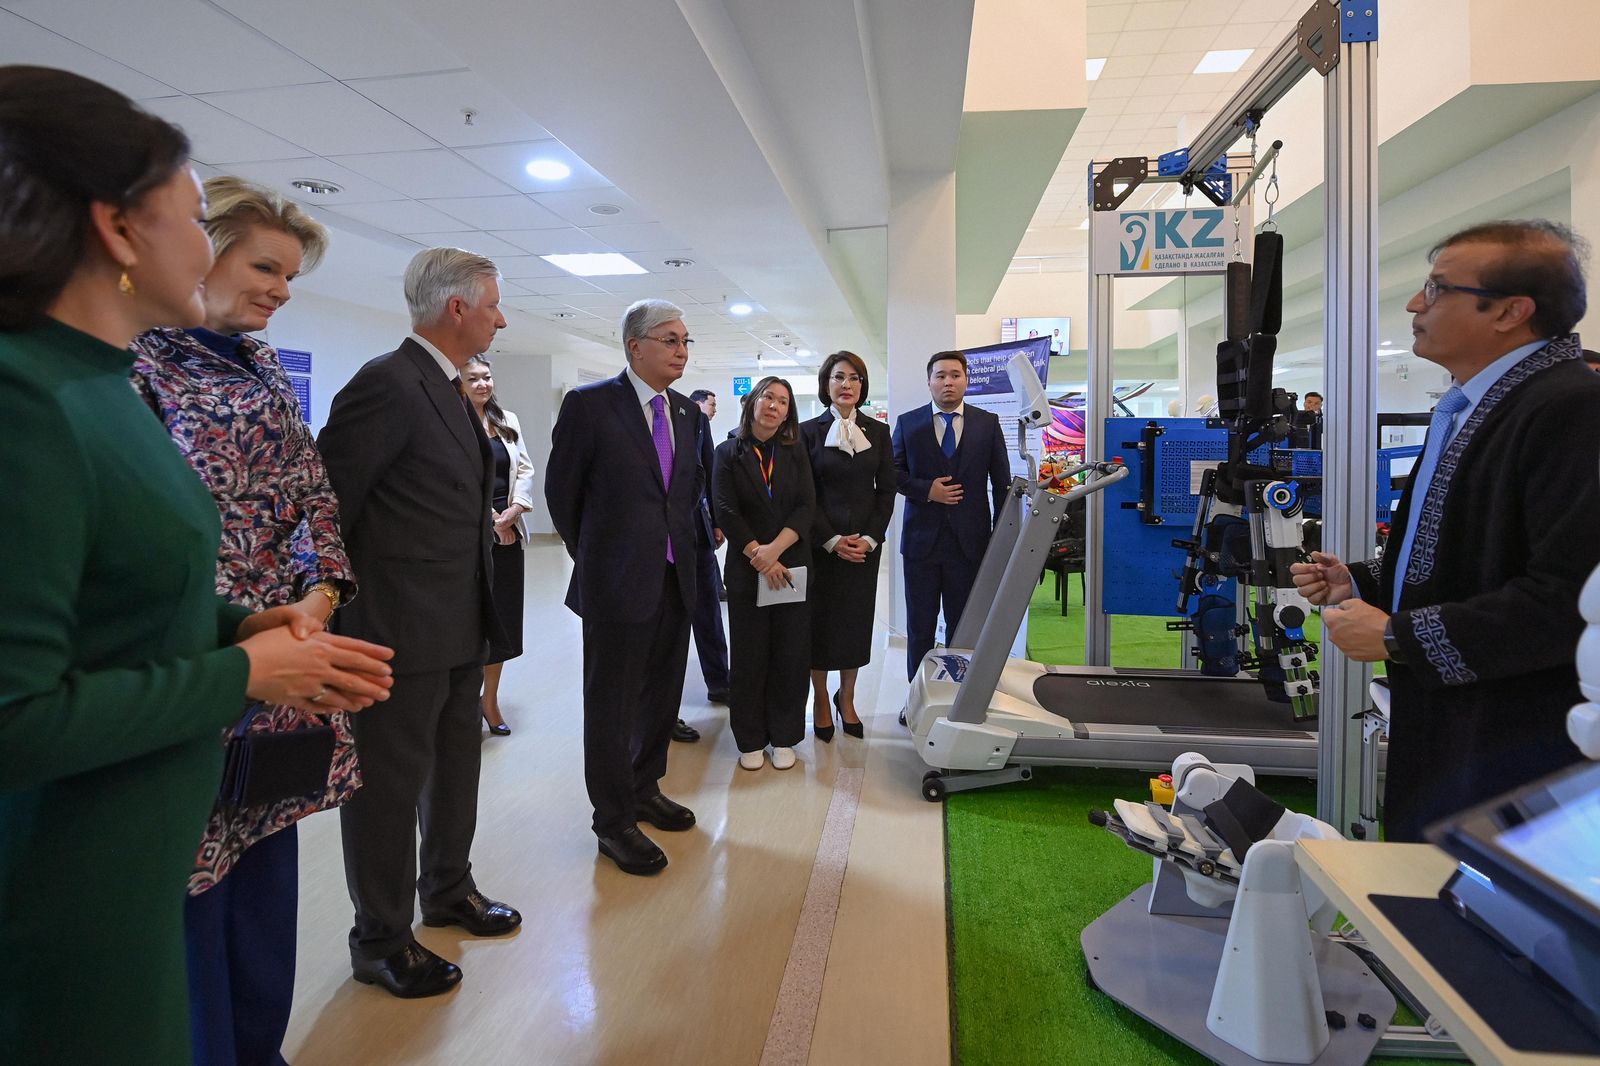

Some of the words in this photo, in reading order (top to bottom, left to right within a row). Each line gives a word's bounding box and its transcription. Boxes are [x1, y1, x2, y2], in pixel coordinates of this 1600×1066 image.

[1155, 209, 1224, 249] KZ
[967, 357, 979, 366] bots
[980, 356, 992, 364] that
[993, 354, 1007, 363] help
[971, 364, 996, 374] cerebral
[1033, 358, 1046, 367] talk
[969, 376, 990, 385] belong
[1086, 679, 1151, 688] alexia
